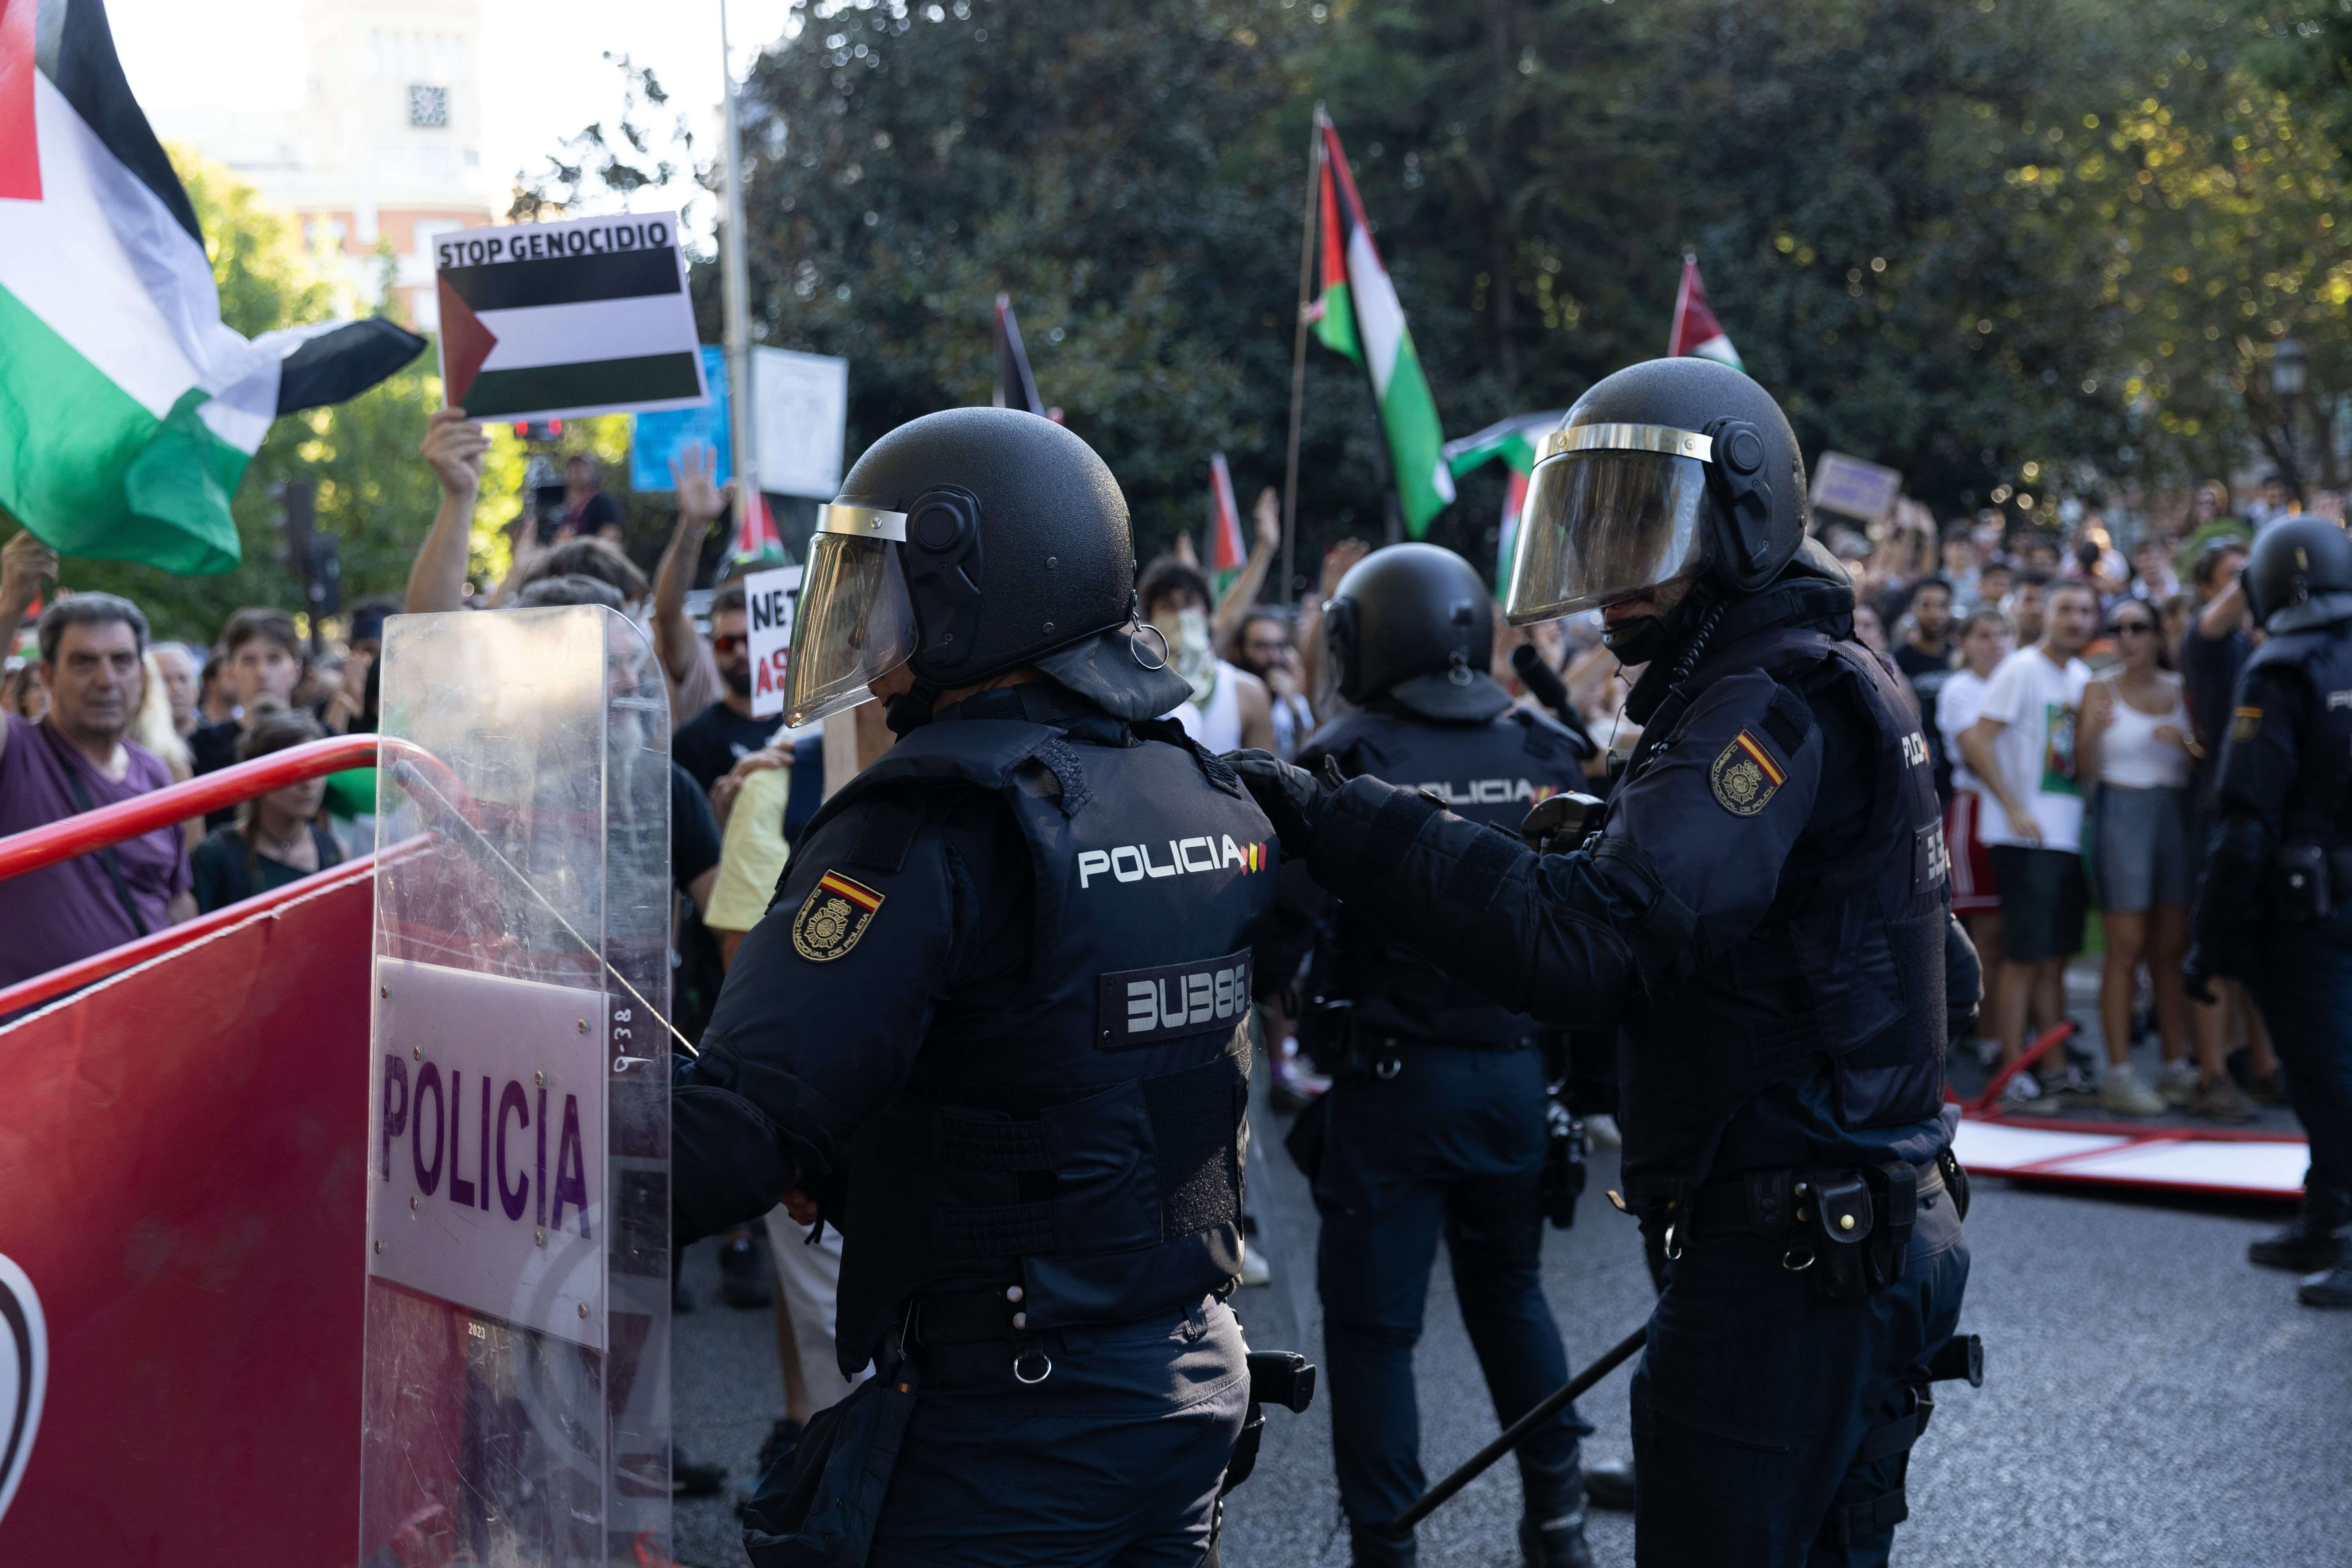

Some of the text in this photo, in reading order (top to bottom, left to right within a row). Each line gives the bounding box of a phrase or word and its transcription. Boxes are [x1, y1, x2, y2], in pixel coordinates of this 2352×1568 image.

[440, 222, 668, 269] STOP GENOCIDIO
[1416, 778, 1537, 805] OLICIA
[1714, 774, 1738, 810] NACIONAL
[1753, 786, 1775, 810] POLICIA
[1078, 834, 1247, 888] POLICIA
[828, 946, 844, 956] DE
[843, 913, 871, 948] POLICIA
[382, 1054, 591, 1240] POLICIA
[468, 1322, 486, 1340] 2023
